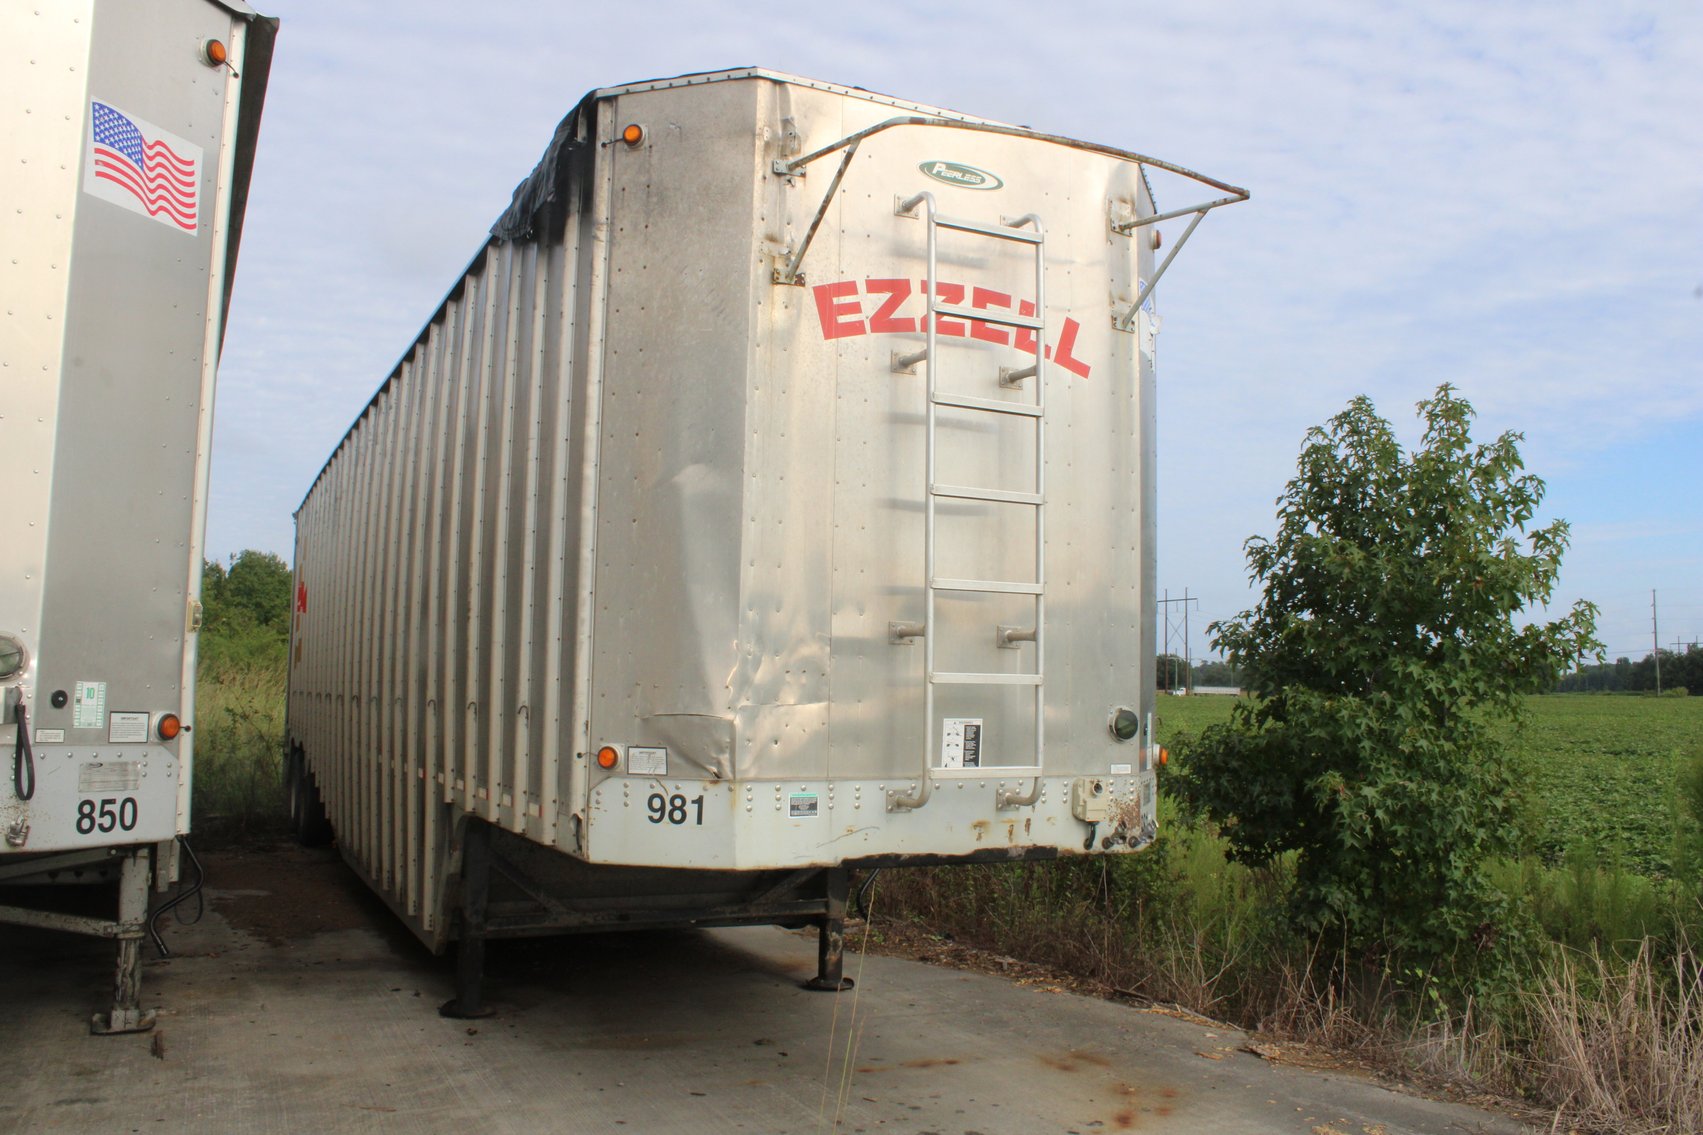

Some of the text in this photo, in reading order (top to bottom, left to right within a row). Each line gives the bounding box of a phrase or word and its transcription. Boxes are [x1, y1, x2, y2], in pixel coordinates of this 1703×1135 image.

[812, 278, 1091, 380] EZZELL
[75, 797, 138, 834] 850
[647, 793, 704, 826] 981
